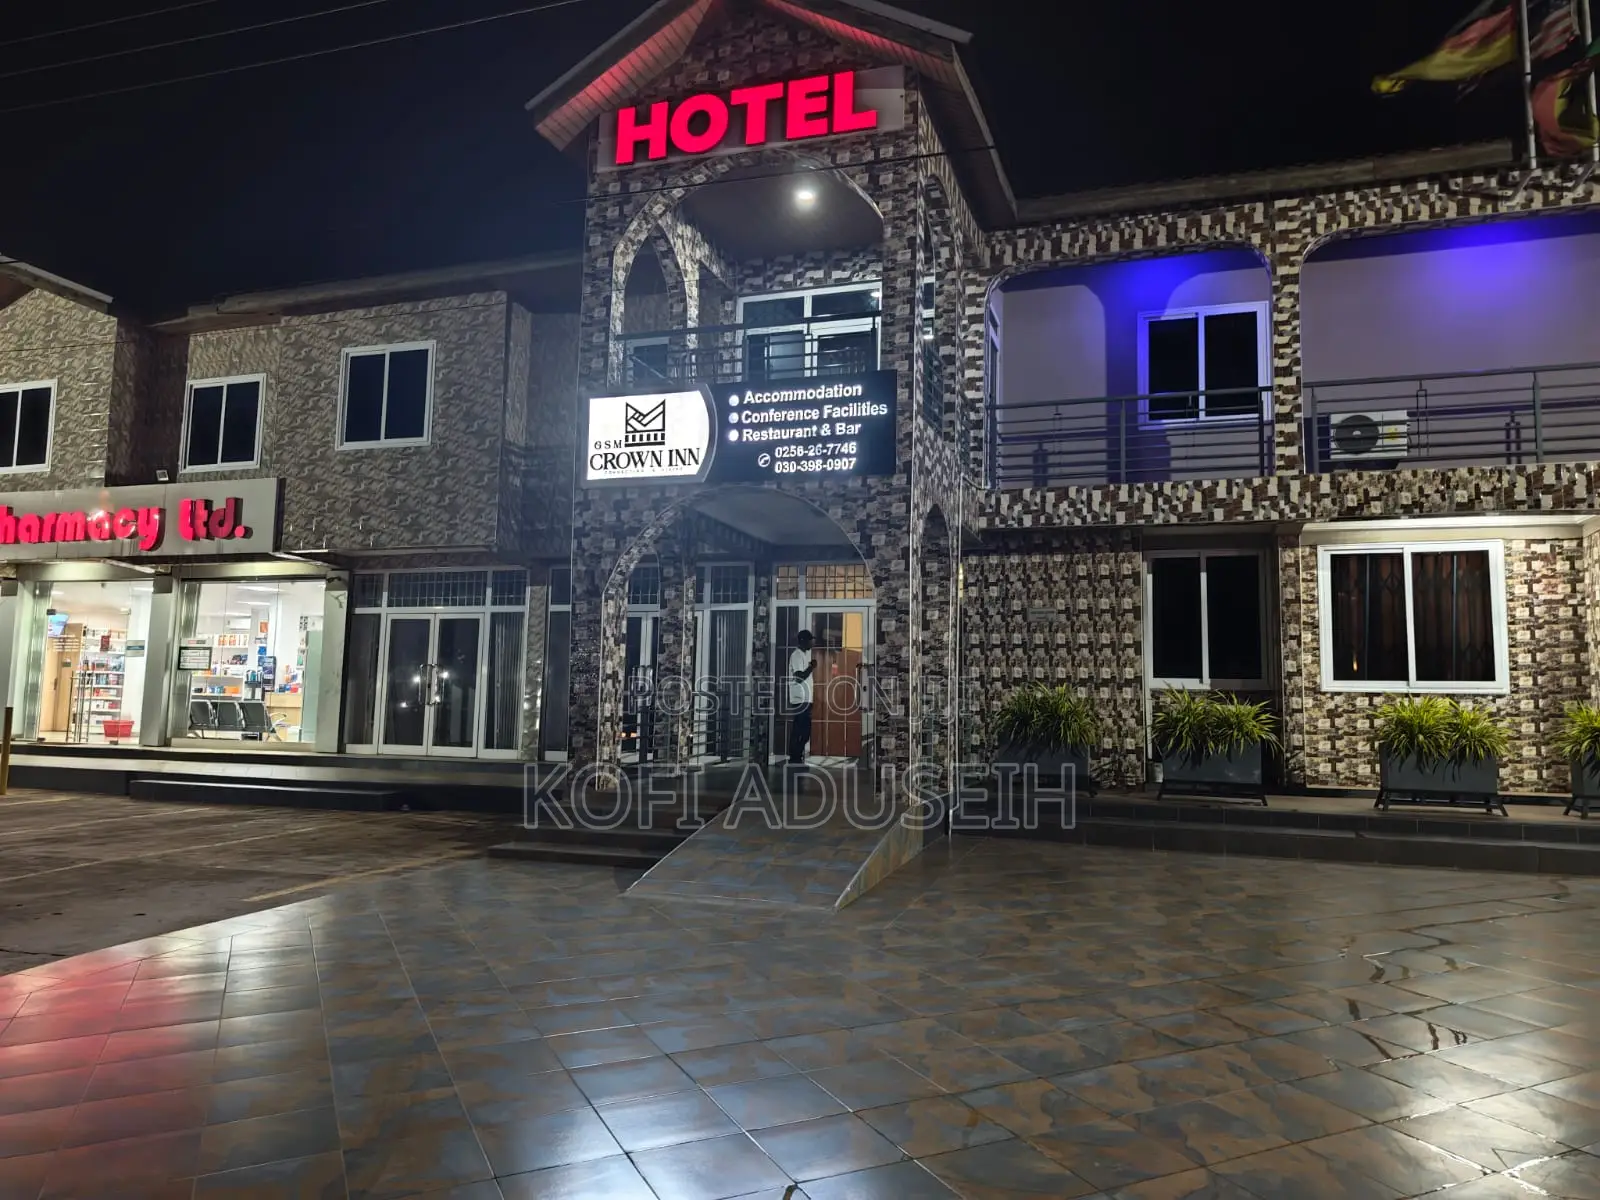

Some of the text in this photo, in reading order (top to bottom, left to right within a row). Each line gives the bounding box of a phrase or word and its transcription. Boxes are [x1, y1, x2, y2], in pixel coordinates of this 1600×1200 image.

[615, 71, 877, 165] HOTEL
[743, 384, 862, 404] Accommodation
[741, 401, 888, 424] Conference Facilities
[742, 422, 861, 441] Restaurant & Bar
[589, 450, 662, 471] CROWN
[668, 447, 700, 467] INN
[774, 458, 857, 473] 030-398-0907
